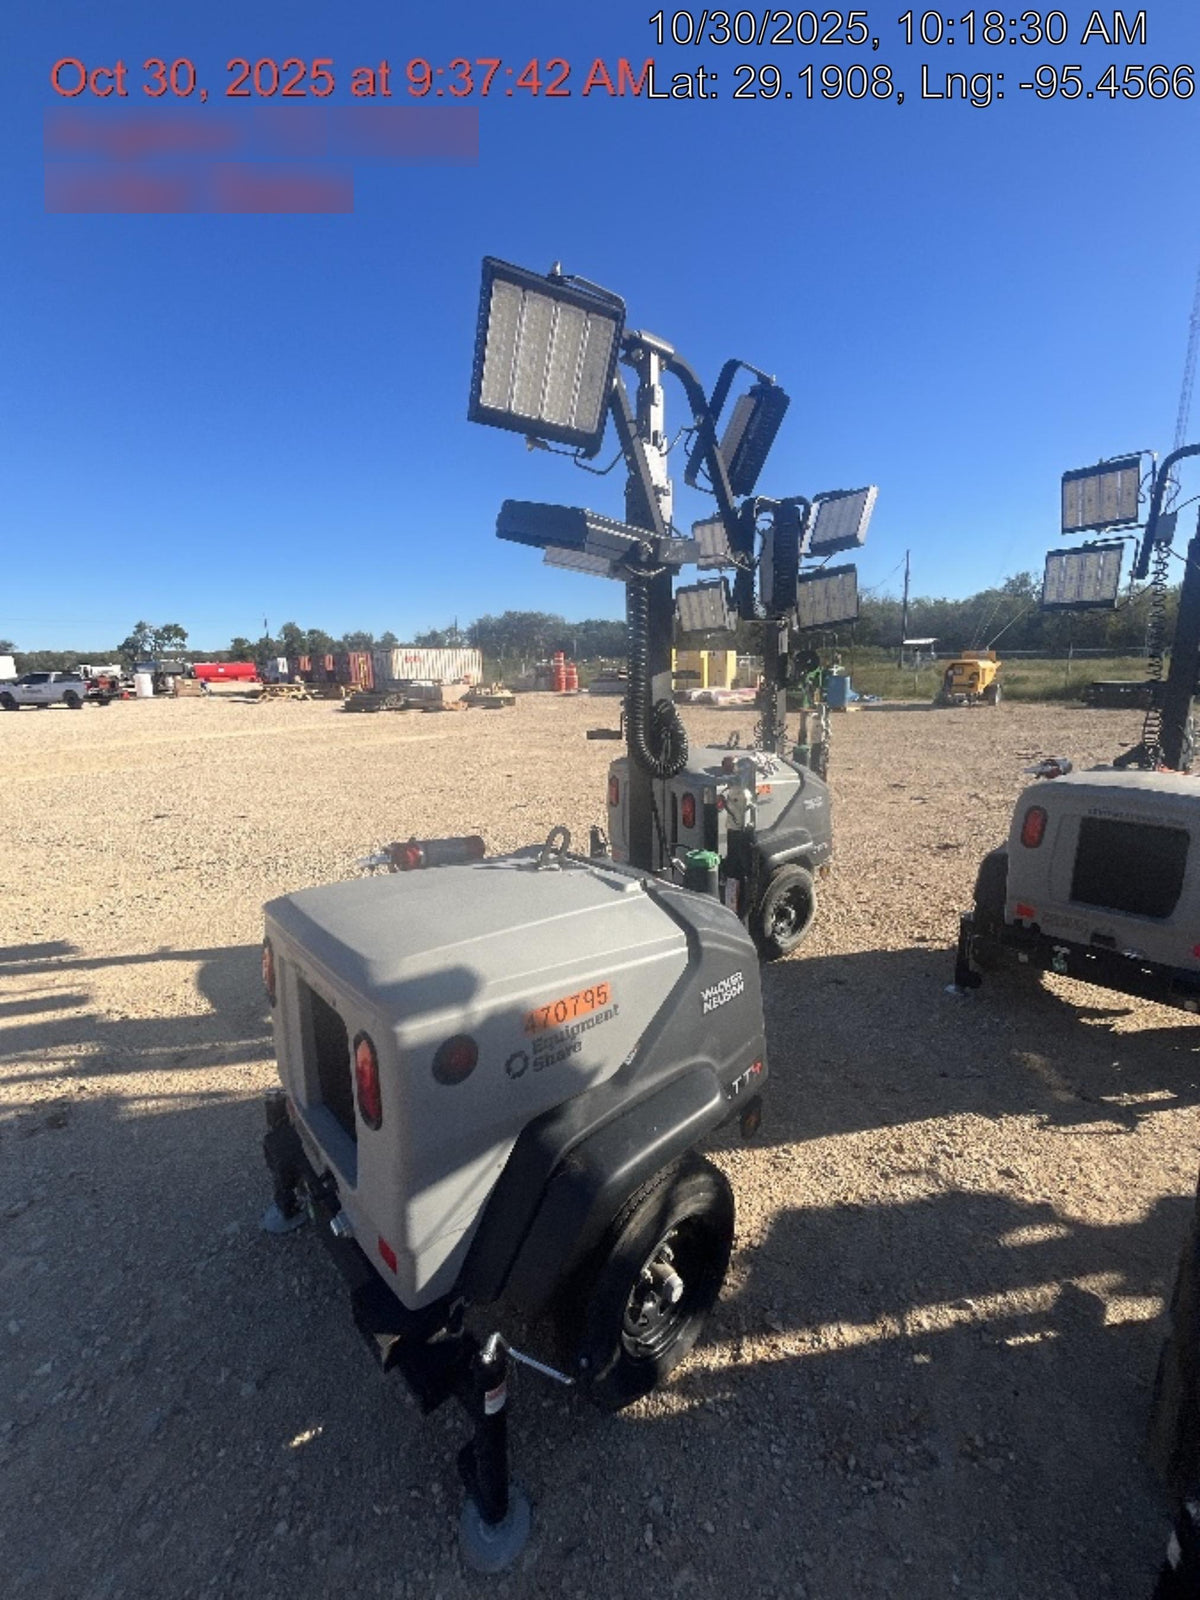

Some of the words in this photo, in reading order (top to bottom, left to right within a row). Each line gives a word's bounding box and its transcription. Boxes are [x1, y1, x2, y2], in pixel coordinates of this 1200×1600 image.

[523, 984, 609, 1034] 470795
[531, 1004, 620, 1055] Equipment
[532, 1041, 583, 1073] Share
